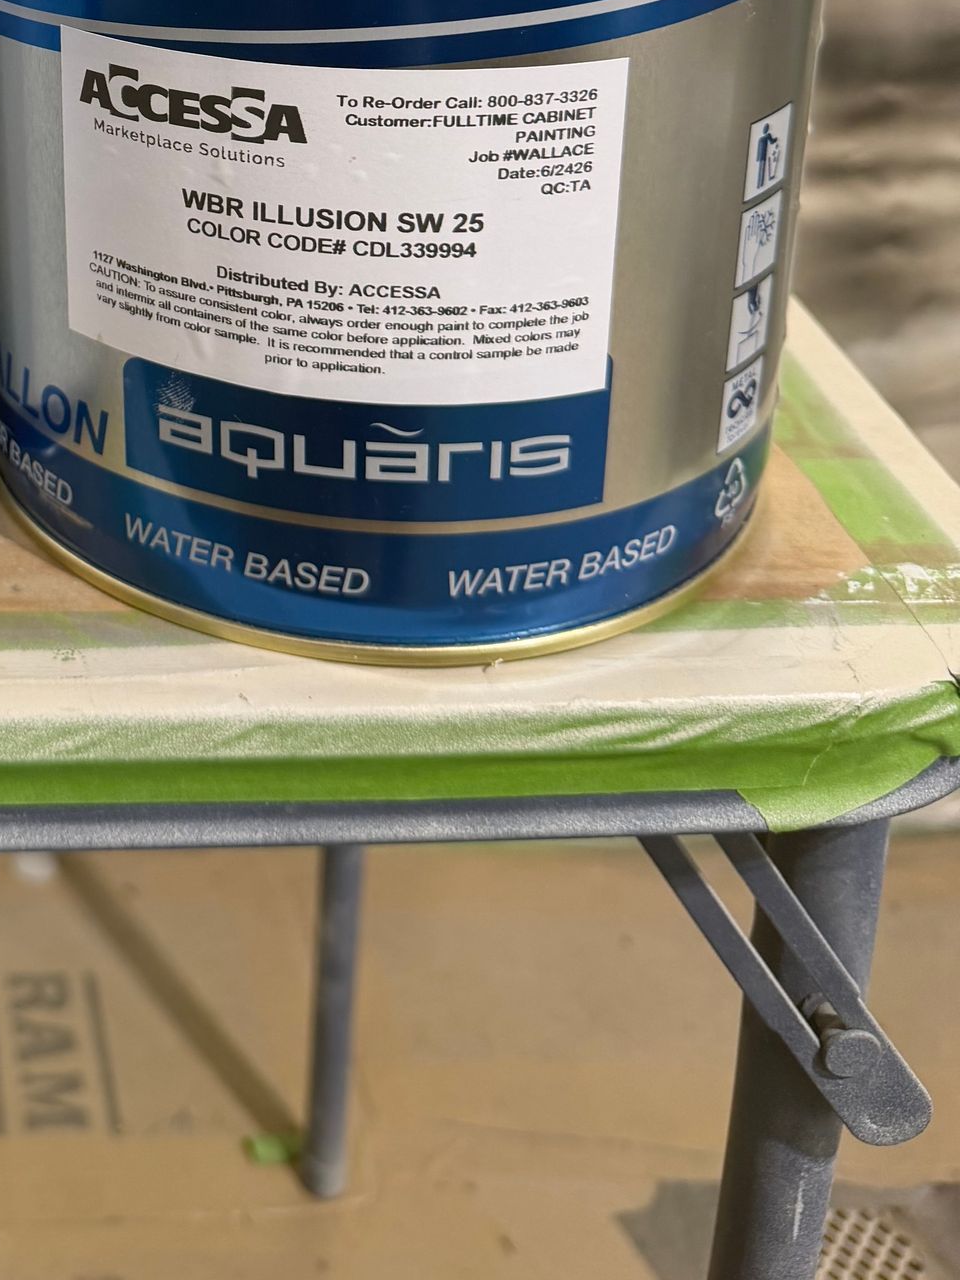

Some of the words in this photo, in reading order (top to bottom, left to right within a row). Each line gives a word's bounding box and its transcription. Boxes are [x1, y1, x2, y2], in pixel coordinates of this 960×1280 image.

[79, 63, 308, 145] ACCESSA
[336, 94, 358, 108] To
[362, 96, 442, 109] Re-Order
[445, 96, 482, 109] Call:
[487, 88, 598, 108] 800-837-3326
[345, 113, 518, 128] Customer:FULLTIME
[522, 107, 597, 124] CABINET
[94, 117, 193, 154] Marketplace
[199, 142, 285, 168] Solutions
[469, 150, 499, 163] Job
[502, 143, 594, 162] #WALLACE
[515, 125, 596, 143] PAINTING
[497, 161, 593, 180] Date:6/2426
[540, 180, 591, 196] QC:TA
[182, 188, 244, 219] WBR
[252, 201, 387, 232] ILLUSION
[397, 212, 444, 233] SW
[452, 213, 484, 233] 25
[187, 218, 261, 246] COLOR
[267, 231, 346, 255] CODE#
[352, 240, 477, 258] CDL339994
[89, 262, 141, 289] CAUTION:
[143, 280, 157, 293] To
[158, 287, 196, 303] assure
[198, 296, 258, 317] consistent
[261, 309, 296, 323] color,
[298, 314, 343, 328] always
[347, 319, 381, 330] order
[384, 320, 434, 334] enough
[437, 321, 469, 334] paint
[472, 320, 485, 331] to
[488, 317, 546, 331] complete
[549, 314, 569, 325] the
[571, 311, 590, 325] job
[93, 250, 114, 264] 1127
[116, 257, 178, 284] Washington
[216, 284, 283, 307] Pittsburgh,
[286, 297, 304, 309] PA
[307, 300, 344, 312] 15206
[357, 303, 379, 315] Tel:
[382, 305, 468, 316] 412-363-9602
[479, 304, 507, 315] Fax:
[509, 296, 589, 313] 412-363-9603
[216, 265, 309, 293] Distributed
[314, 280, 343, 298] By:
[348, 284, 441, 299] ACCESSA
[96, 279, 114, 292] and
[116, 284, 156, 307] intermix
[158, 298, 171, 311] all
[173, 304, 233, 326] containers
[235, 318, 247, 329] of
[249, 321, 269, 332] the
[272, 326, 308, 338] same
[311, 330, 344, 342] color
[346, 331, 388, 345] before
[391, 335, 465, 349] application.
[472, 333, 511, 345] Mixed
[514, 331, 552, 343] colors
[555, 327, 581, 340] may
[97, 293, 117, 309] vary
[119, 299, 154, 321] slightly
[155, 312, 181, 327] from
[183, 321, 211, 334] color
[214, 327, 260, 346] sample.
[267, 336, 276, 348] It
[278, 338, 290, 350] is
[292, 342, 386, 359] recommended
[389, 349, 414, 360] that
[416, 352, 426, 360] a
[428, 349, 473, 360] control
[476, 347, 523, 360] sample
[526, 344, 542, 356] be
[545, 341, 579, 354] made
[264, 353, 293, 366] prior
[296, 357, 308, 368] to
[311, 360, 386, 375] application.
[9, 438, 73, 505] BASED
[125, 512, 235, 571] WATER
[244, 551, 371, 595] BASED
[448, 558, 571, 598] WATER
[578, 524, 678, 581] BASED
[4, 971, 91, 1132] RAM
